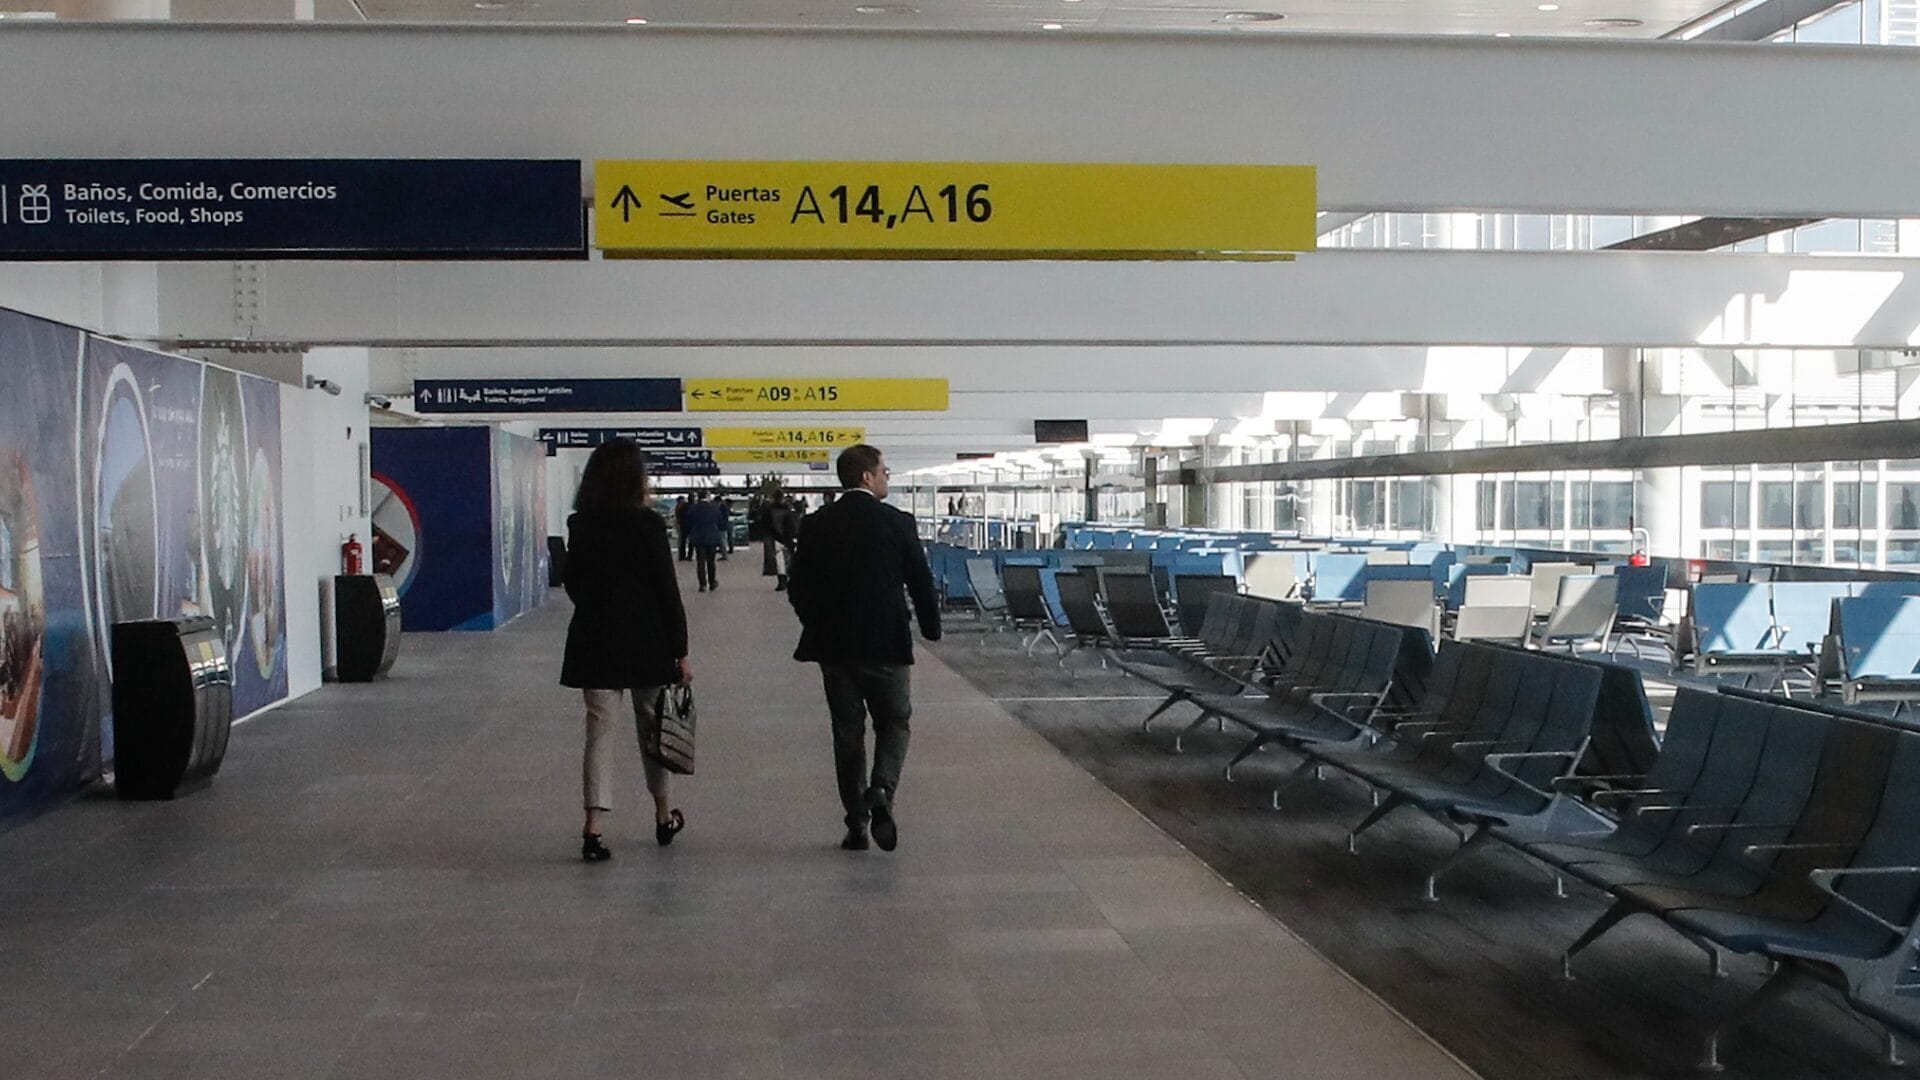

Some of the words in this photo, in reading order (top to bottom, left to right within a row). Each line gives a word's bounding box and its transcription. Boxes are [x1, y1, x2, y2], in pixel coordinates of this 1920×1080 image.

[63, 183, 133, 203] Baños,
[139, 182, 224, 203] Comida,
[230, 182, 337, 200] Comercios
[706, 185, 781, 202] Puertas
[64, 207, 130, 227] Toilets,
[135, 207, 185, 227] Food,
[190, 207, 244, 228] Shops
[706, 210, 755, 225] Gates
[757, 386, 791, 402] A09
[804, 386, 838, 402] A15
